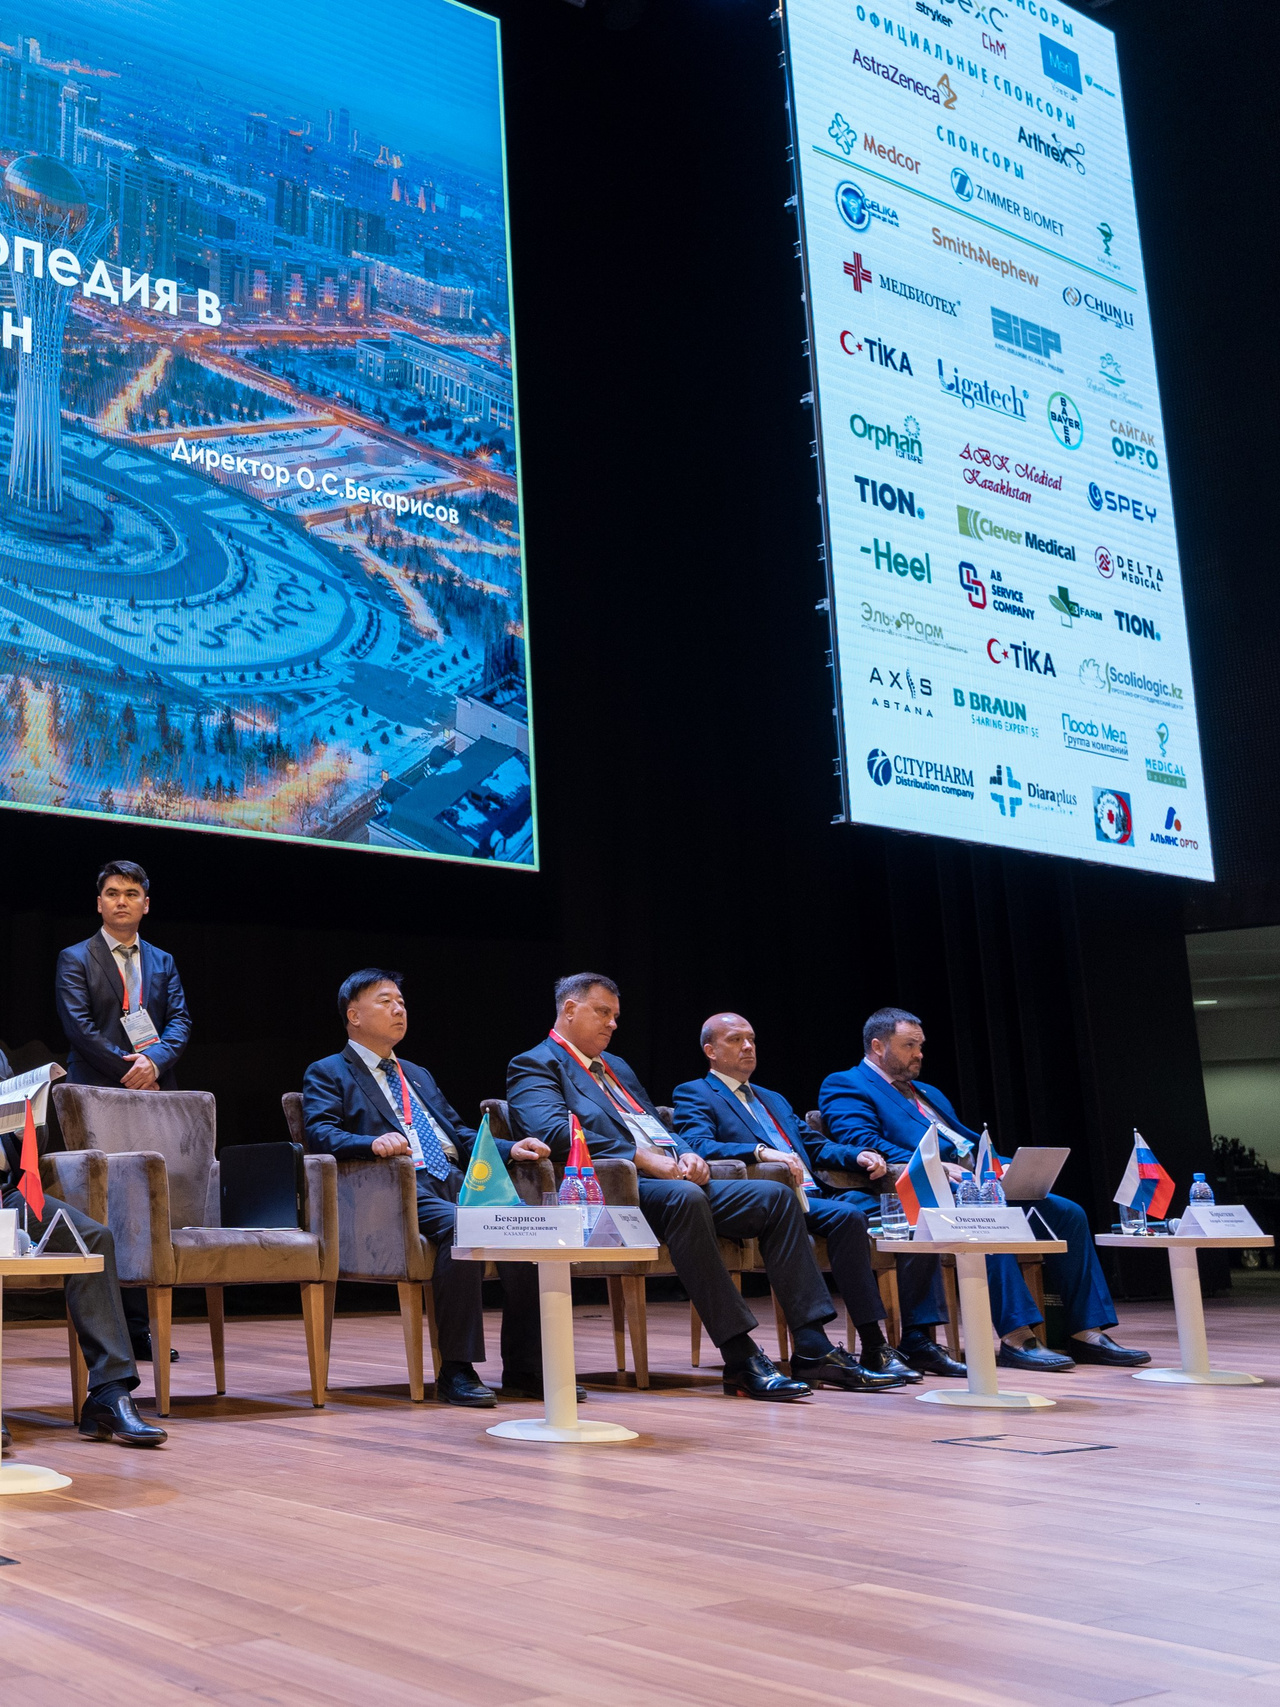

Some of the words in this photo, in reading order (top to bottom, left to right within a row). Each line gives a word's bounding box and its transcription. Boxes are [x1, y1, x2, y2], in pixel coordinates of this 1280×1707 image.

[915, 1, 954, 28] stryker
[852, 48, 941, 105] AstraZeneca
[856, 4, 988, 84] ОФИЦИАЛЬНЫЕ
[994, 75, 1076, 130] СПОНСОРЫ
[863, 132, 921, 174] Medcor
[936, 125, 1024, 180] СПОНСОРЫ
[1018, 126, 1070, 168] Arthrex
[975, 184, 1020, 217] ZIMMER
[1023, 206, 1064, 237] BIOMET
[198, 291, 223, 328] в
[878, 273, 957, 317] МЕДБИОТЕХ
[937, 358, 1027, 418] Ligatech
[849, 413, 923, 457] Orphan
[1050, 411, 1081, 431] BAYER
[1060, 396, 1072, 446] BAYER
[1109, 419, 1156, 448] САЙГАК
[171, 436, 291, 488] Директор
[296, 465, 461, 526] О.С.Бекарисов
[962, 467, 1032, 503] Kazakhstan
[1014, 463, 1063, 491] Medical
[1104, 489, 1157, 523] SPEY
[979, 518, 1023, 545] Clever
[1025, 531, 1076, 562] Medical
[990, 569, 1002, 582] AB
[1121, 570, 1162, 592] MEDICAL
[991, 584, 1024, 603] SERVICE
[992, 599, 1035, 621] COMPANY
[1080, 606, 1103, 621] FARM
[1109, 666, 1184, 700] Scoliologic.kz
[871, 697, 934, 718] ASTANA
[953, 687, 966, 707] B
[969, 691, 1027, 722] BRAUN
[893, 755, 975, 788] CITYPHARM
[895, 775, 940, 793] Distribution
[941, 786, 975, 800] company
[1027, 782, 1078, 807] Diaraplus
[1150, 832, 1179, 847] АЛЬЯНС
[494, 1214, 546, 1224] Бекарисов
